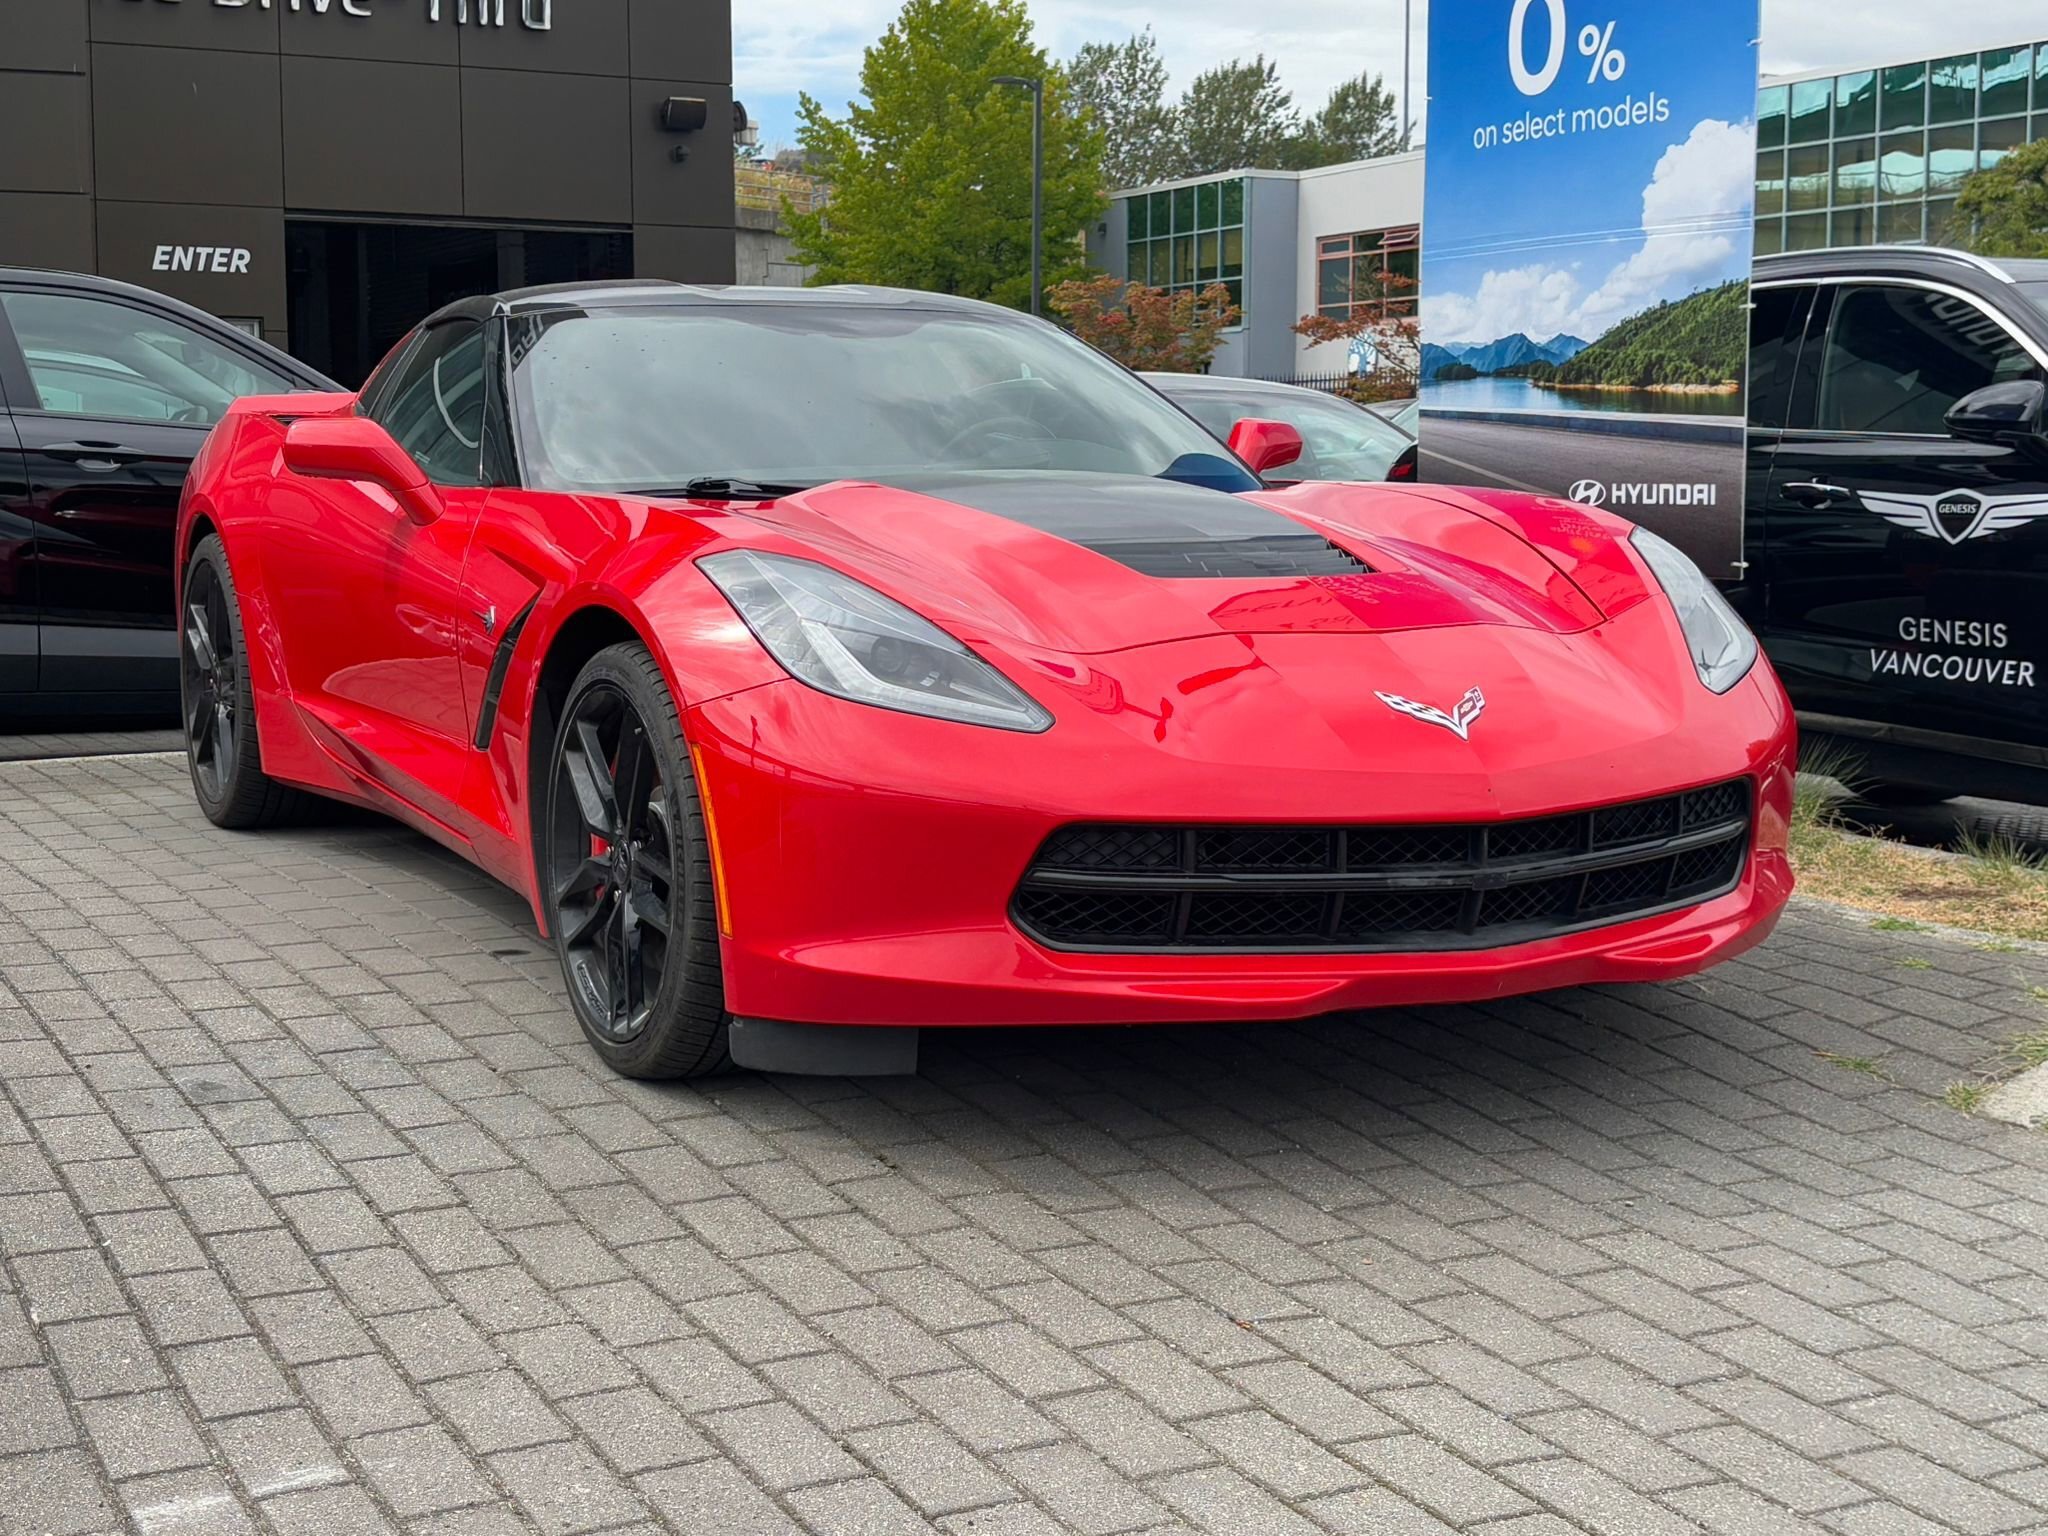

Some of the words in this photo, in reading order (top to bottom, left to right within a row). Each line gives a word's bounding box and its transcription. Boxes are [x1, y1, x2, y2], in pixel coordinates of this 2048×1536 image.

[1508, 0, 1566, 96] 0
[1578, 21, 1627, 84] %
[1472, 125, 1498, 150] on
[1501, 108, 1567, 145] select
[1571, 91, 1671, 134] models
[152, 245, 251, 273] ENTER
[1611, 483, 1716, 506] HYUNDAI
[1938, 503, 1977, 514] GENESIS
[1898, 617, 2008, 648] GENESIS
[1869, 648, 2035, 688] VANCOUVER
